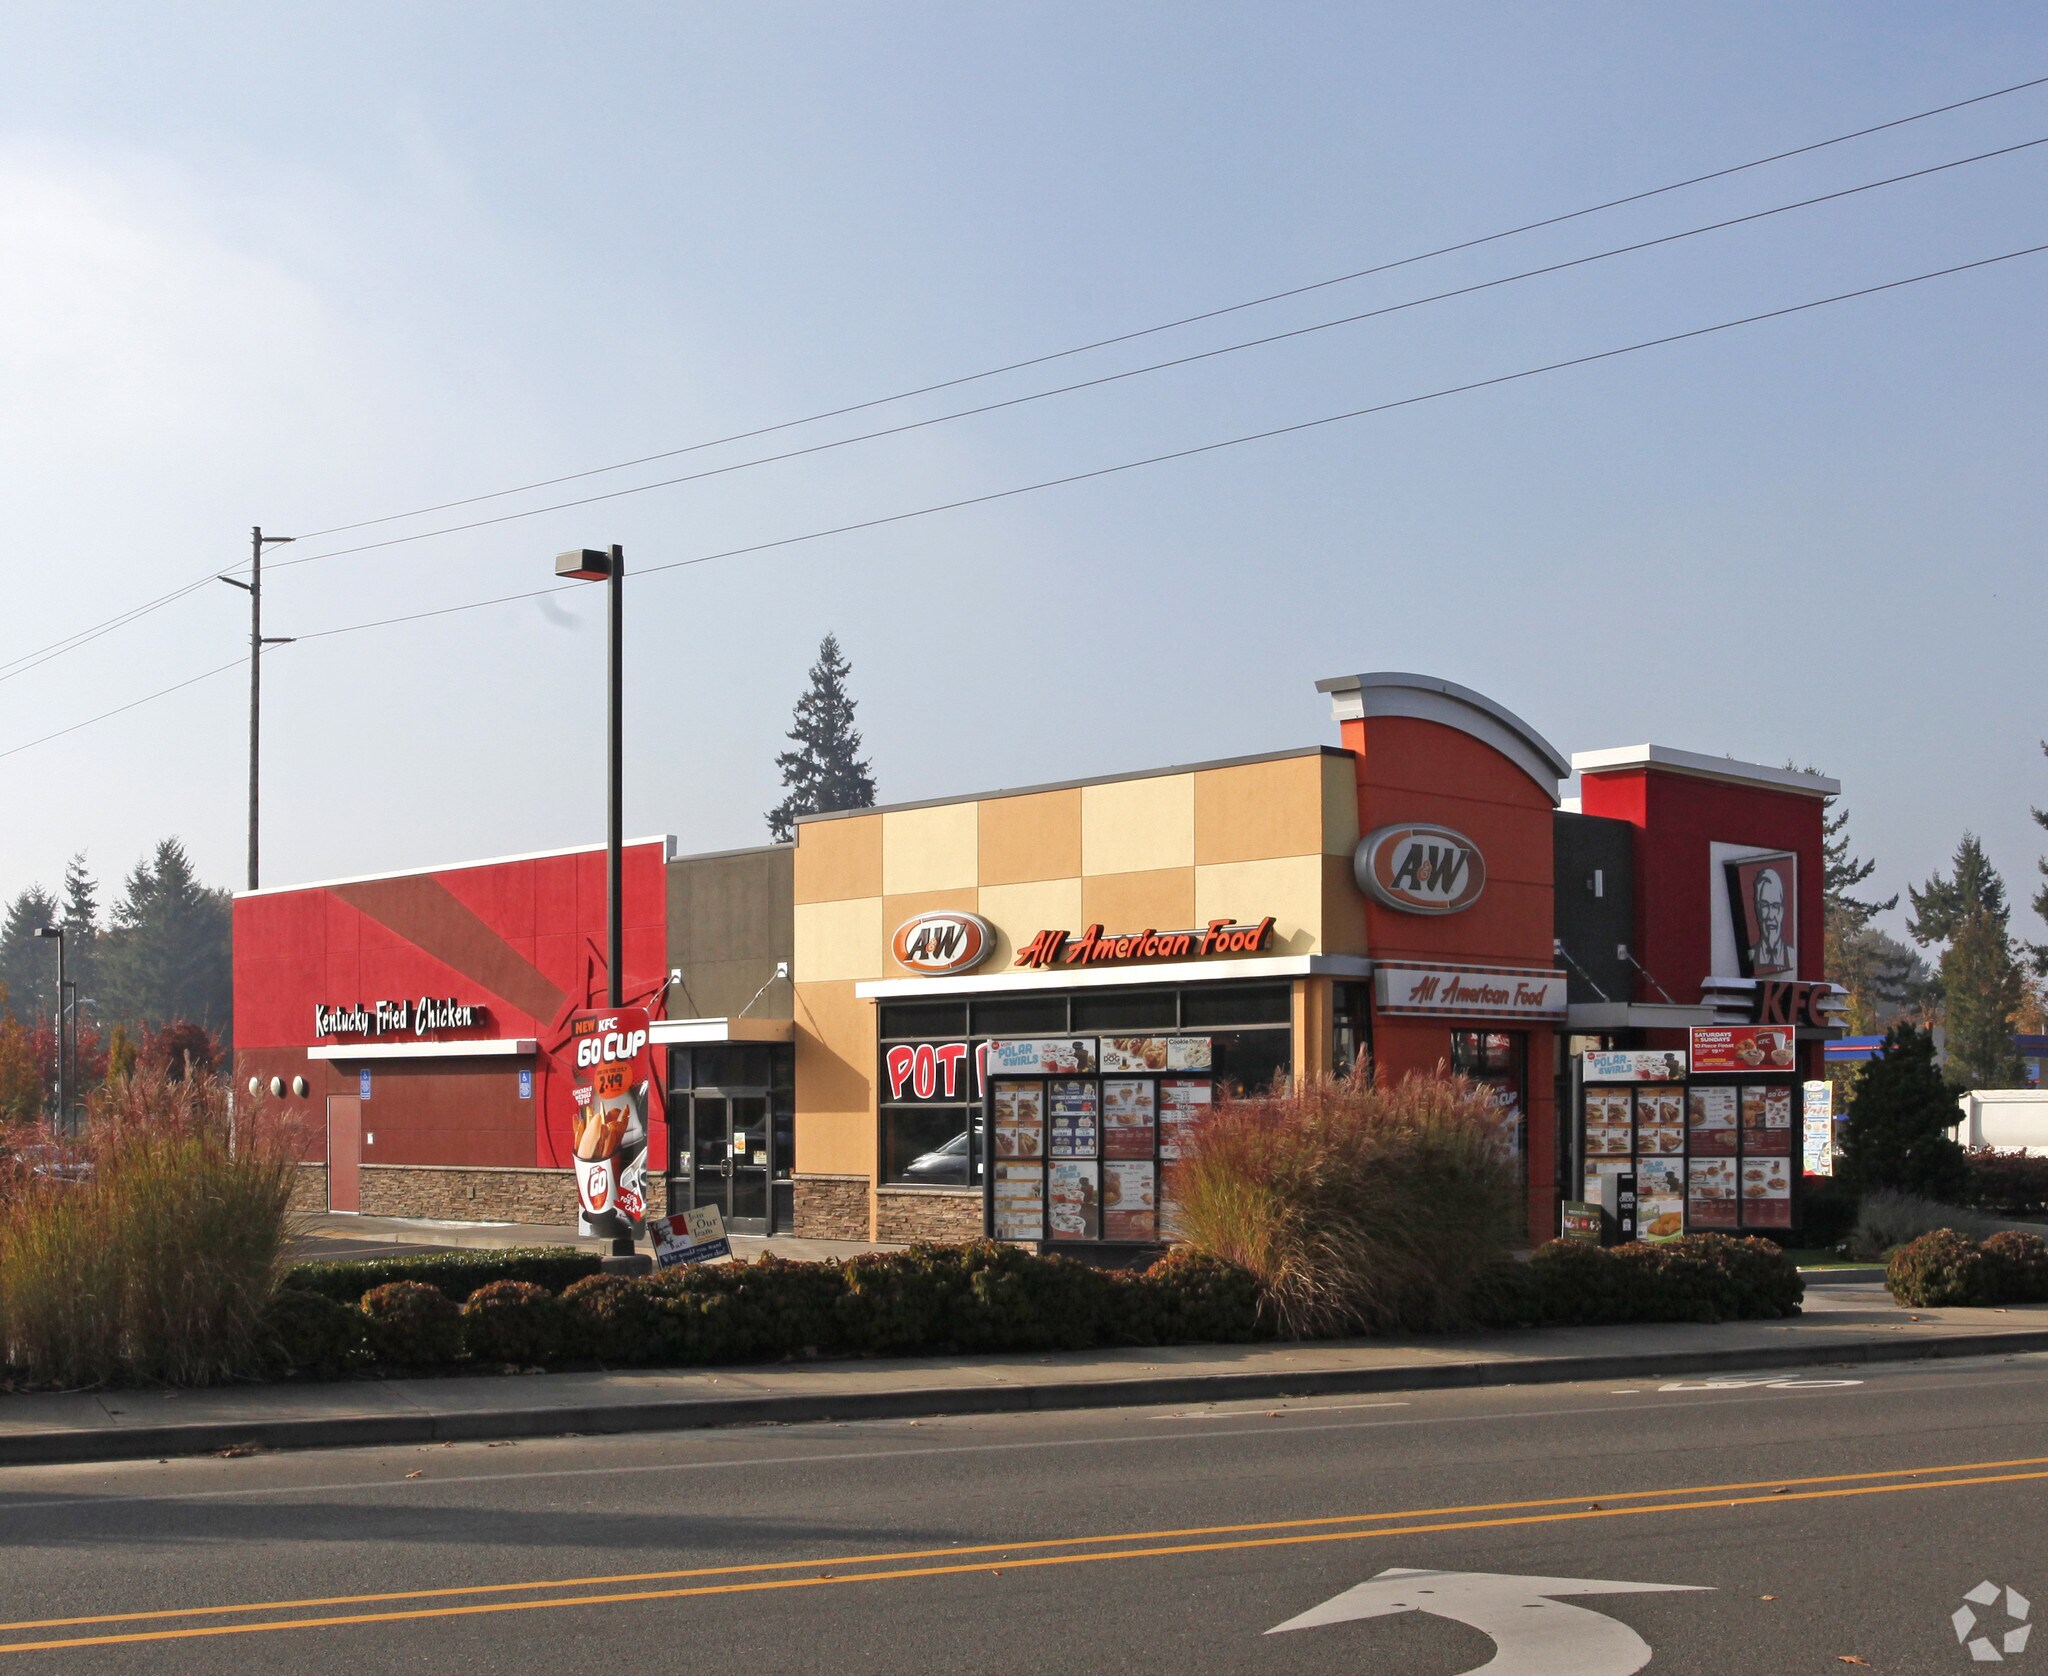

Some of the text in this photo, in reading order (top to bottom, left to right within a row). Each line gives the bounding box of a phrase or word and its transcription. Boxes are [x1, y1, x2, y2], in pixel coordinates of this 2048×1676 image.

[1388, 843, 1470, 895] A&W
[904, 923, 967, 961] A&W
[1014, 917, 1275, 968] All American Food
[1408, 975, 1548, 1006] All American Food
[1759, 980, 1832, 1027] KFC
[315, 996, 472, 1038] Kentucky Fried Chicken
[575, 1017, 618, 1034] NEW KFC
[577, 1029, 646, 1067] GO CUP
[998, 1043, 1033, 1058] POLAR
[886, 1042, 968, 1100] POT
[1002, 1054, 1039, 1066] SWIRLS
[1593, 1055, 1627, 1067] POLAR
[1598, 1063, 1633, 1075] SWIRLS
[1499, 1091, 1518, 1106] CUP
[589, 1170, 607, 1197] GO
[688, 1212, 704, 1222] Join
[696, 1217, 718, 1229] Our
[691, 1228, 713, 1238] Team
